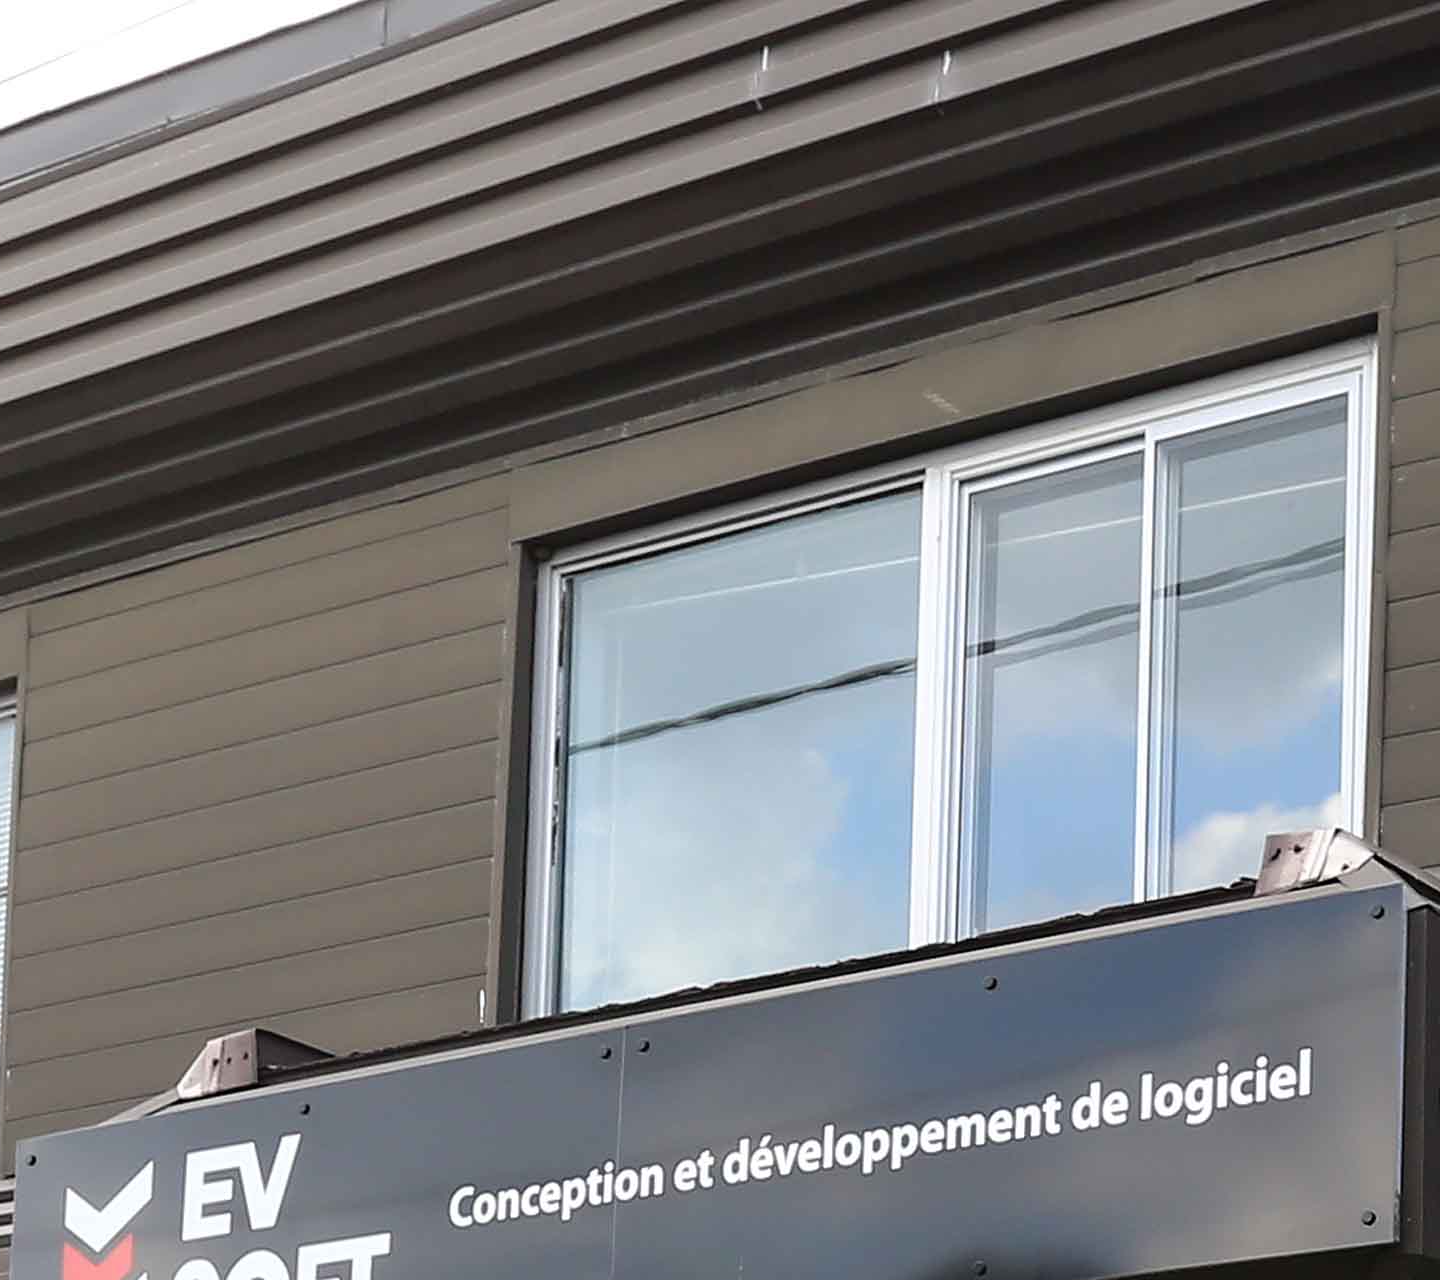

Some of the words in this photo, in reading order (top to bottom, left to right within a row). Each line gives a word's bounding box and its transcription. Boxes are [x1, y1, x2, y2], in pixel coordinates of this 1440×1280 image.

[181, 1132, 302, 1242] EV
[448, 1161, 664, 1228] Conception
[673, 1149, 714, 1191] et
[722, 1093, 1062, 1184] développement
[1071, 1080, 1129, 1130] de
[1139, 1047, 1312, 1126] logiciel
